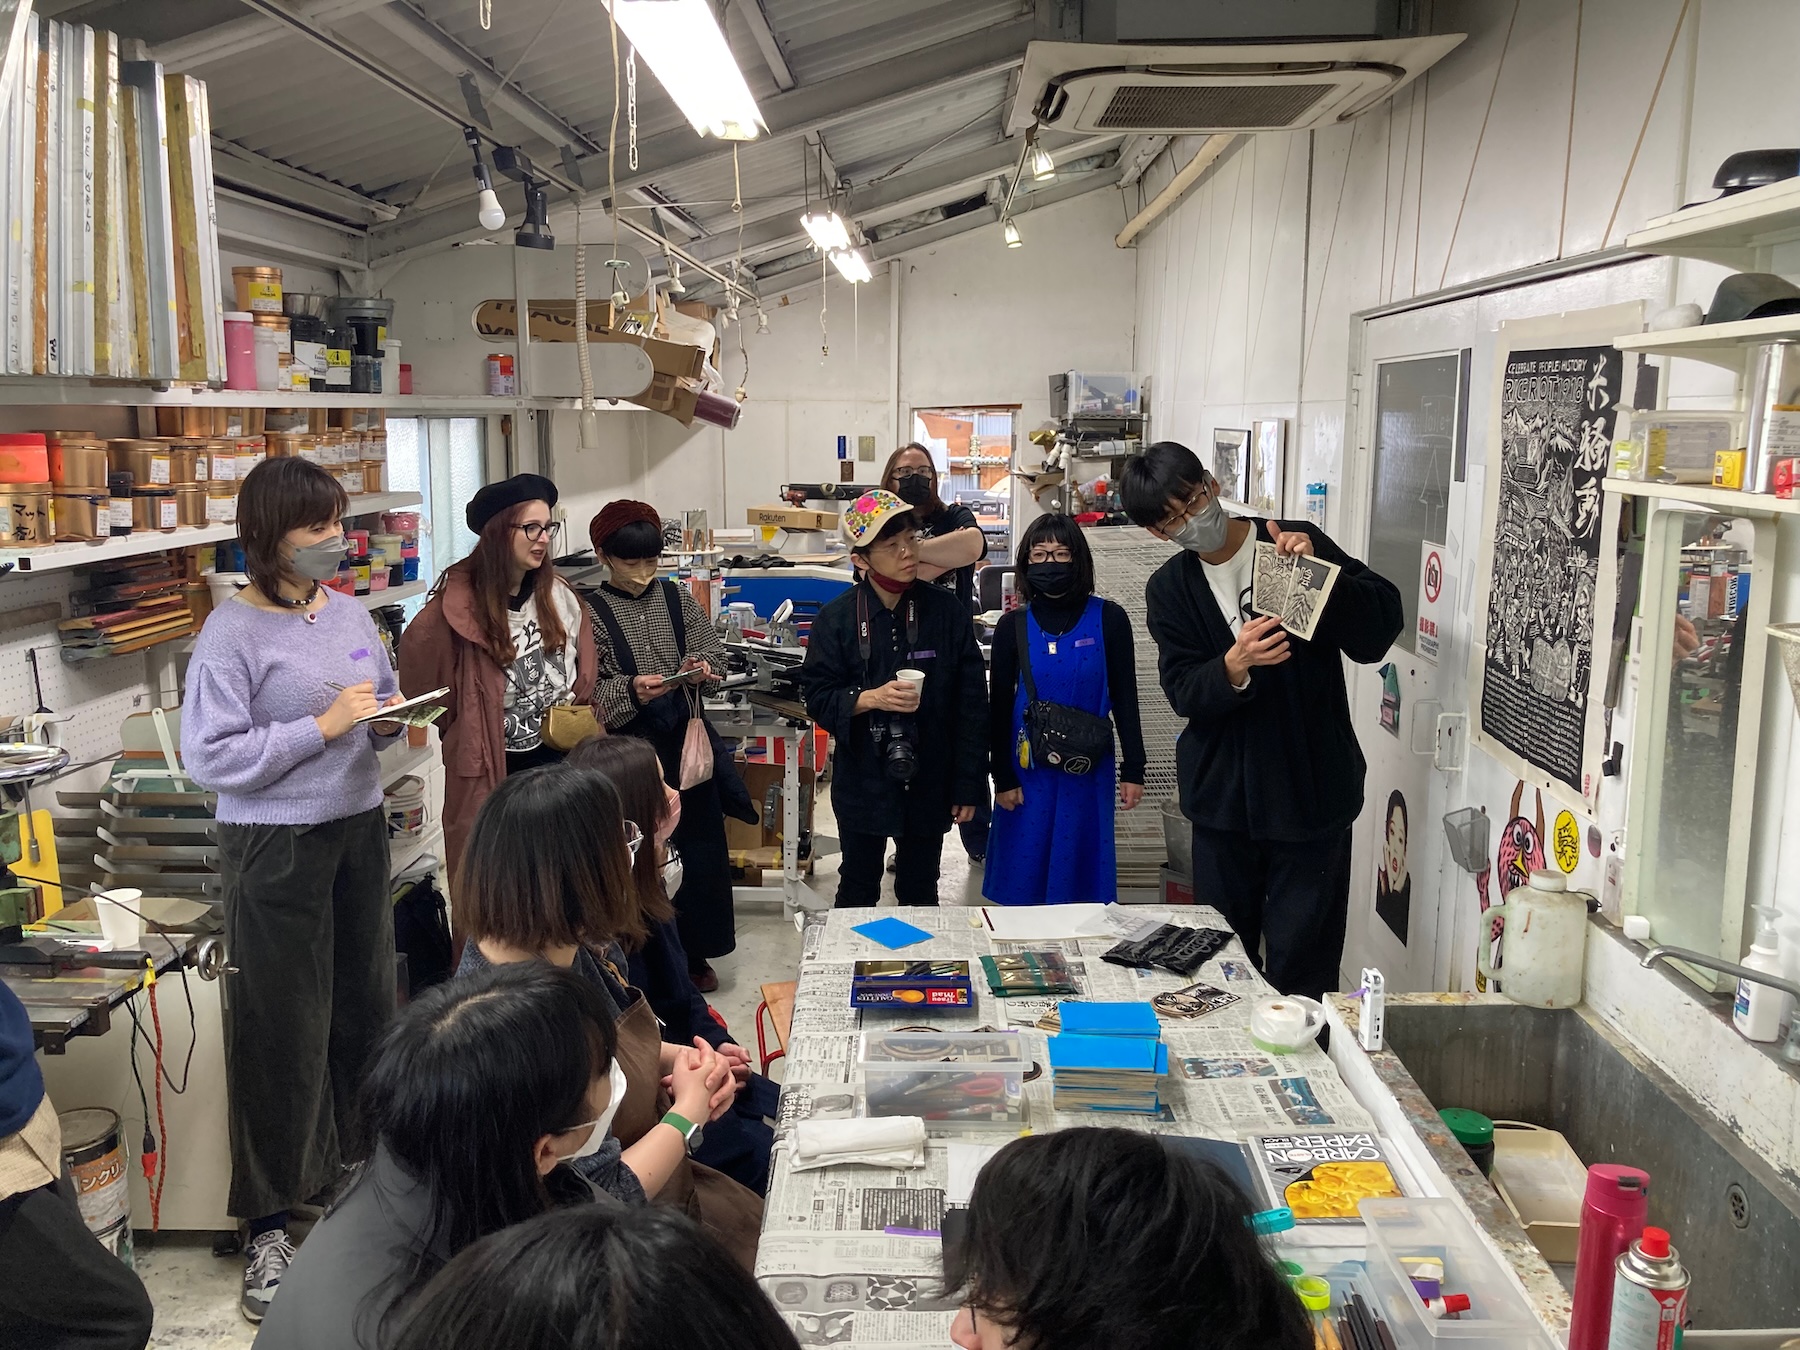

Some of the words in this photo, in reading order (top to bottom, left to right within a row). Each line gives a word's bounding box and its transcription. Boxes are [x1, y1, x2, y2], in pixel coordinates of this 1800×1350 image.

[1561, 359, 1588, 371] HISTORY
[1558, 375, 1585, 403] 1918
[1422, 401, 1452, 434] Toilet
[12, 503, 46, 521] マット
[758, 512, 786, 523] Rakuten
[1294, 1133, 1376, 1148] PAPER
[1266, 1147, 1380, 1164] CARBON
